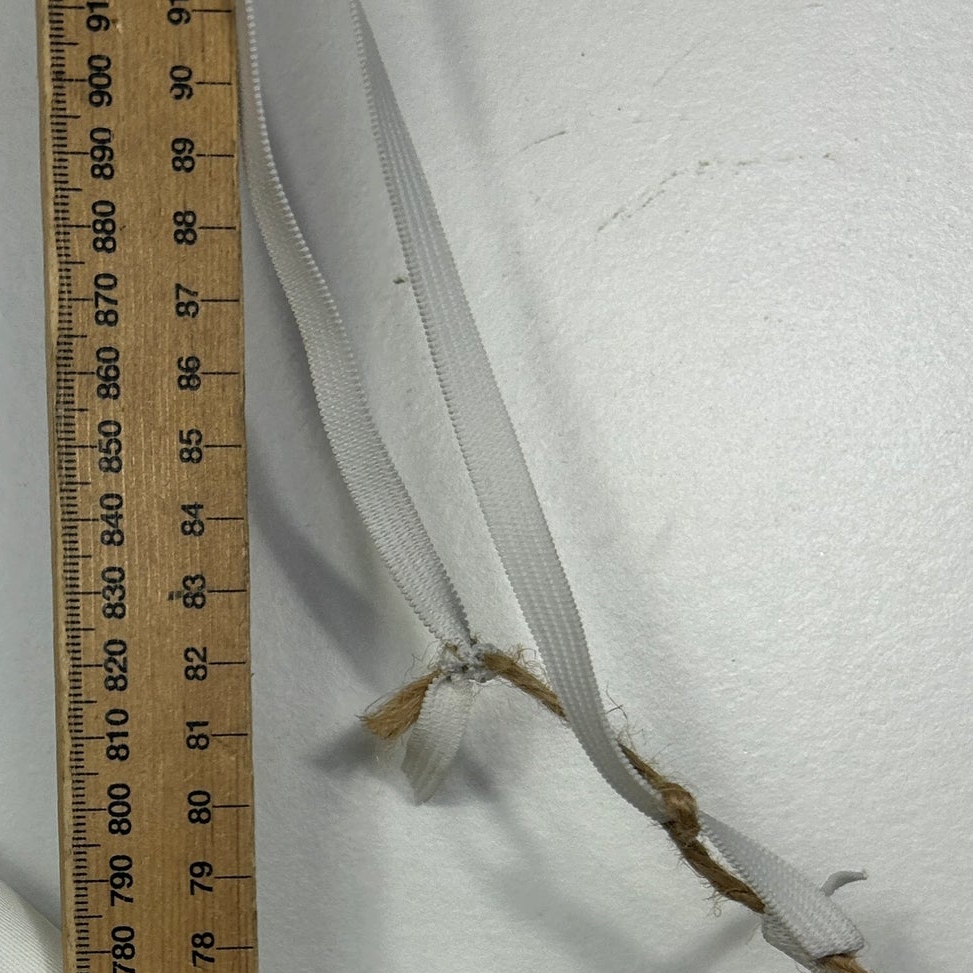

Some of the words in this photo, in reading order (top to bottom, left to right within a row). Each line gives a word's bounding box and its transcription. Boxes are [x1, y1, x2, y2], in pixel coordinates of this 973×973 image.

[88, 55, 112, 107] 900
[170, 65, 194, 100] 90
[90, 127, 115, 180] 890
[172, 138, 196, 172] 89
[92, 200, 117, 253] 880
[174, 210, 198, 245] 88
[95, 273, 119, 327] 870
[176, 283, 199, 318] 87
[97, 346, 121, 400] 860
[178, 355, 201, 391] 86
[99, 420, 122, 473] 850
[180, 429, 203, 464] 85
[101, 493, 124, 547] 840
[182, 502, 205, 536] 84
[103, 566, 126, 619] 830
[183, 574, 207, 609] 83
[105, 639, 128, 691] 820
[185, 646, 208, 681] 82
[106, 709, 130, 761] 810
[187, 719, 210, 749] 81
[107, 783, 132, 835] 800
[188, 790, 212, 824] 80
[110, 854, 134, 906] 790
[190, 861, 214, 895] 79
[192, 931, 216, 966] 78
